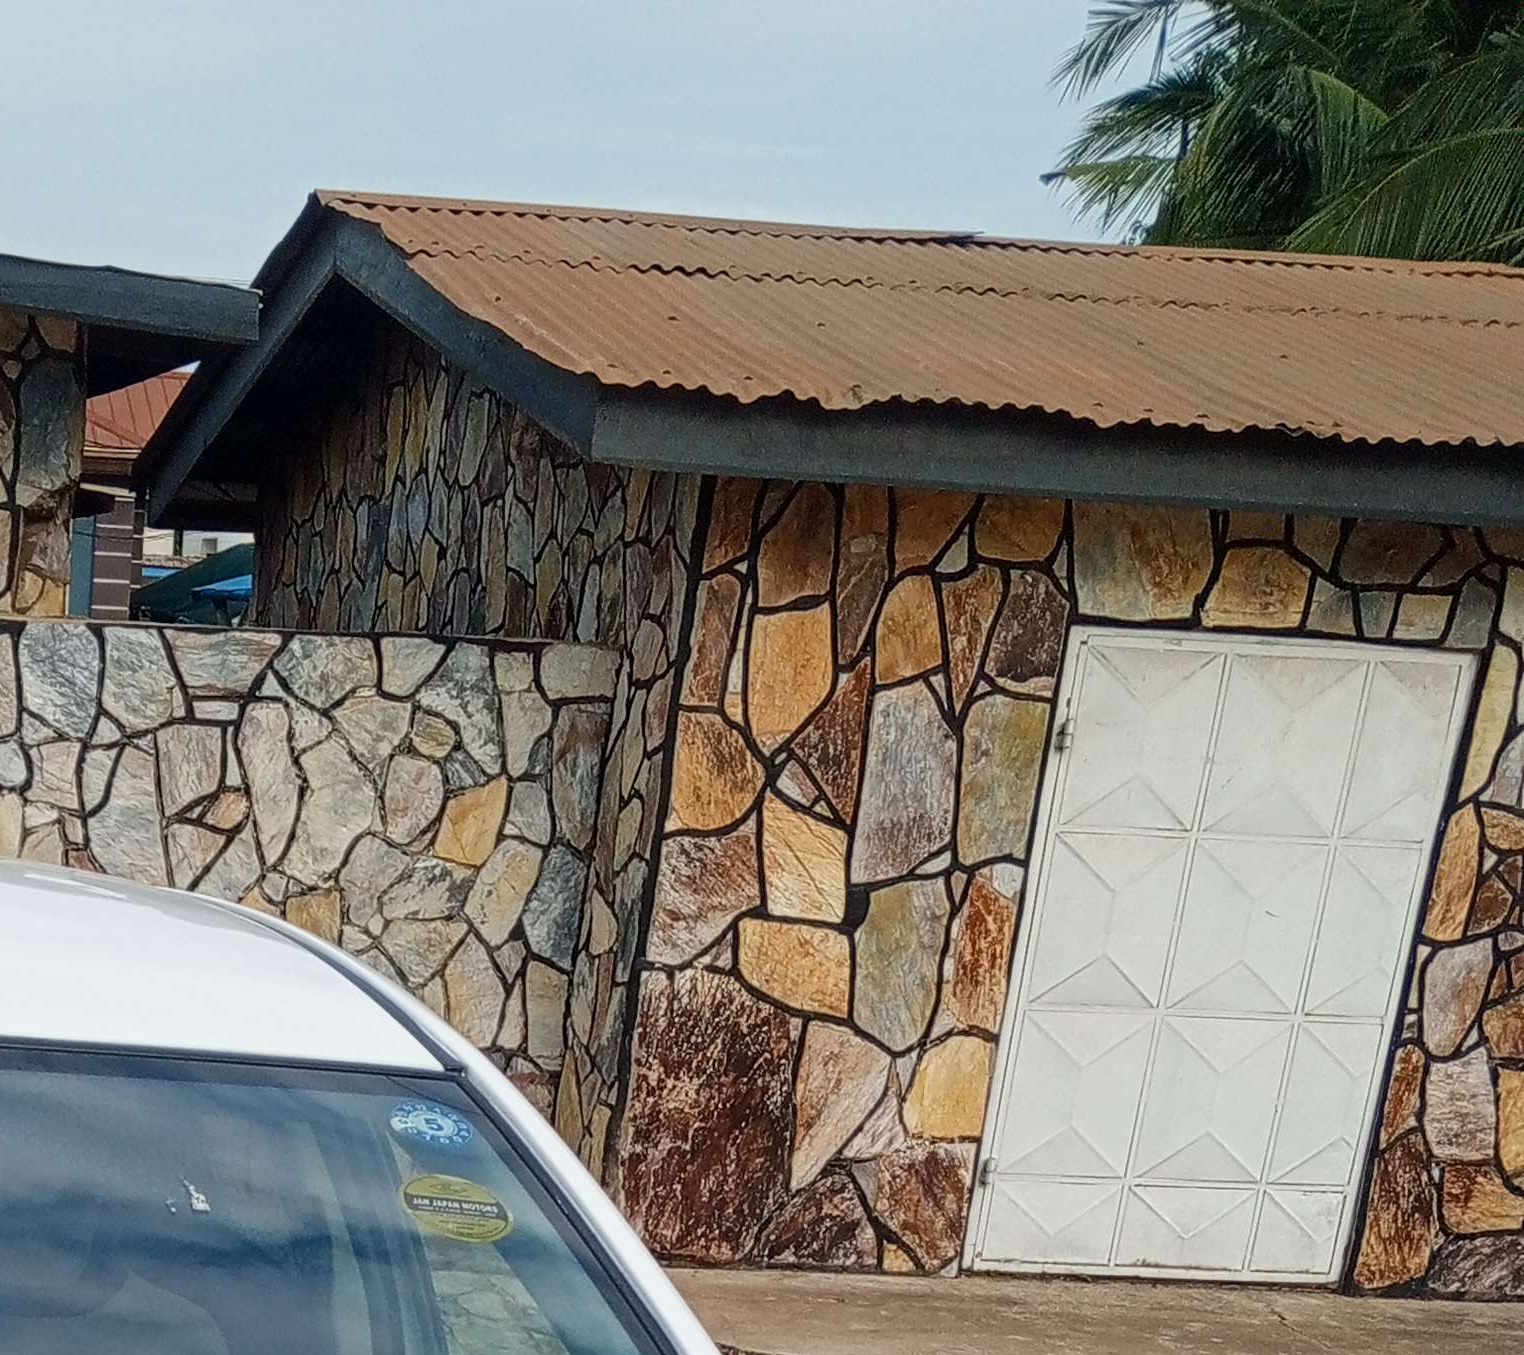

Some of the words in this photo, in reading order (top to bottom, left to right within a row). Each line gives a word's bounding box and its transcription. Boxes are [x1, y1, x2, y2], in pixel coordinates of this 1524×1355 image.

[423, 1117, 445, 1132] 5
[432, 1199, 461, 1209] JAPAN
[461, 1202, 499, 1214] MOTORS
